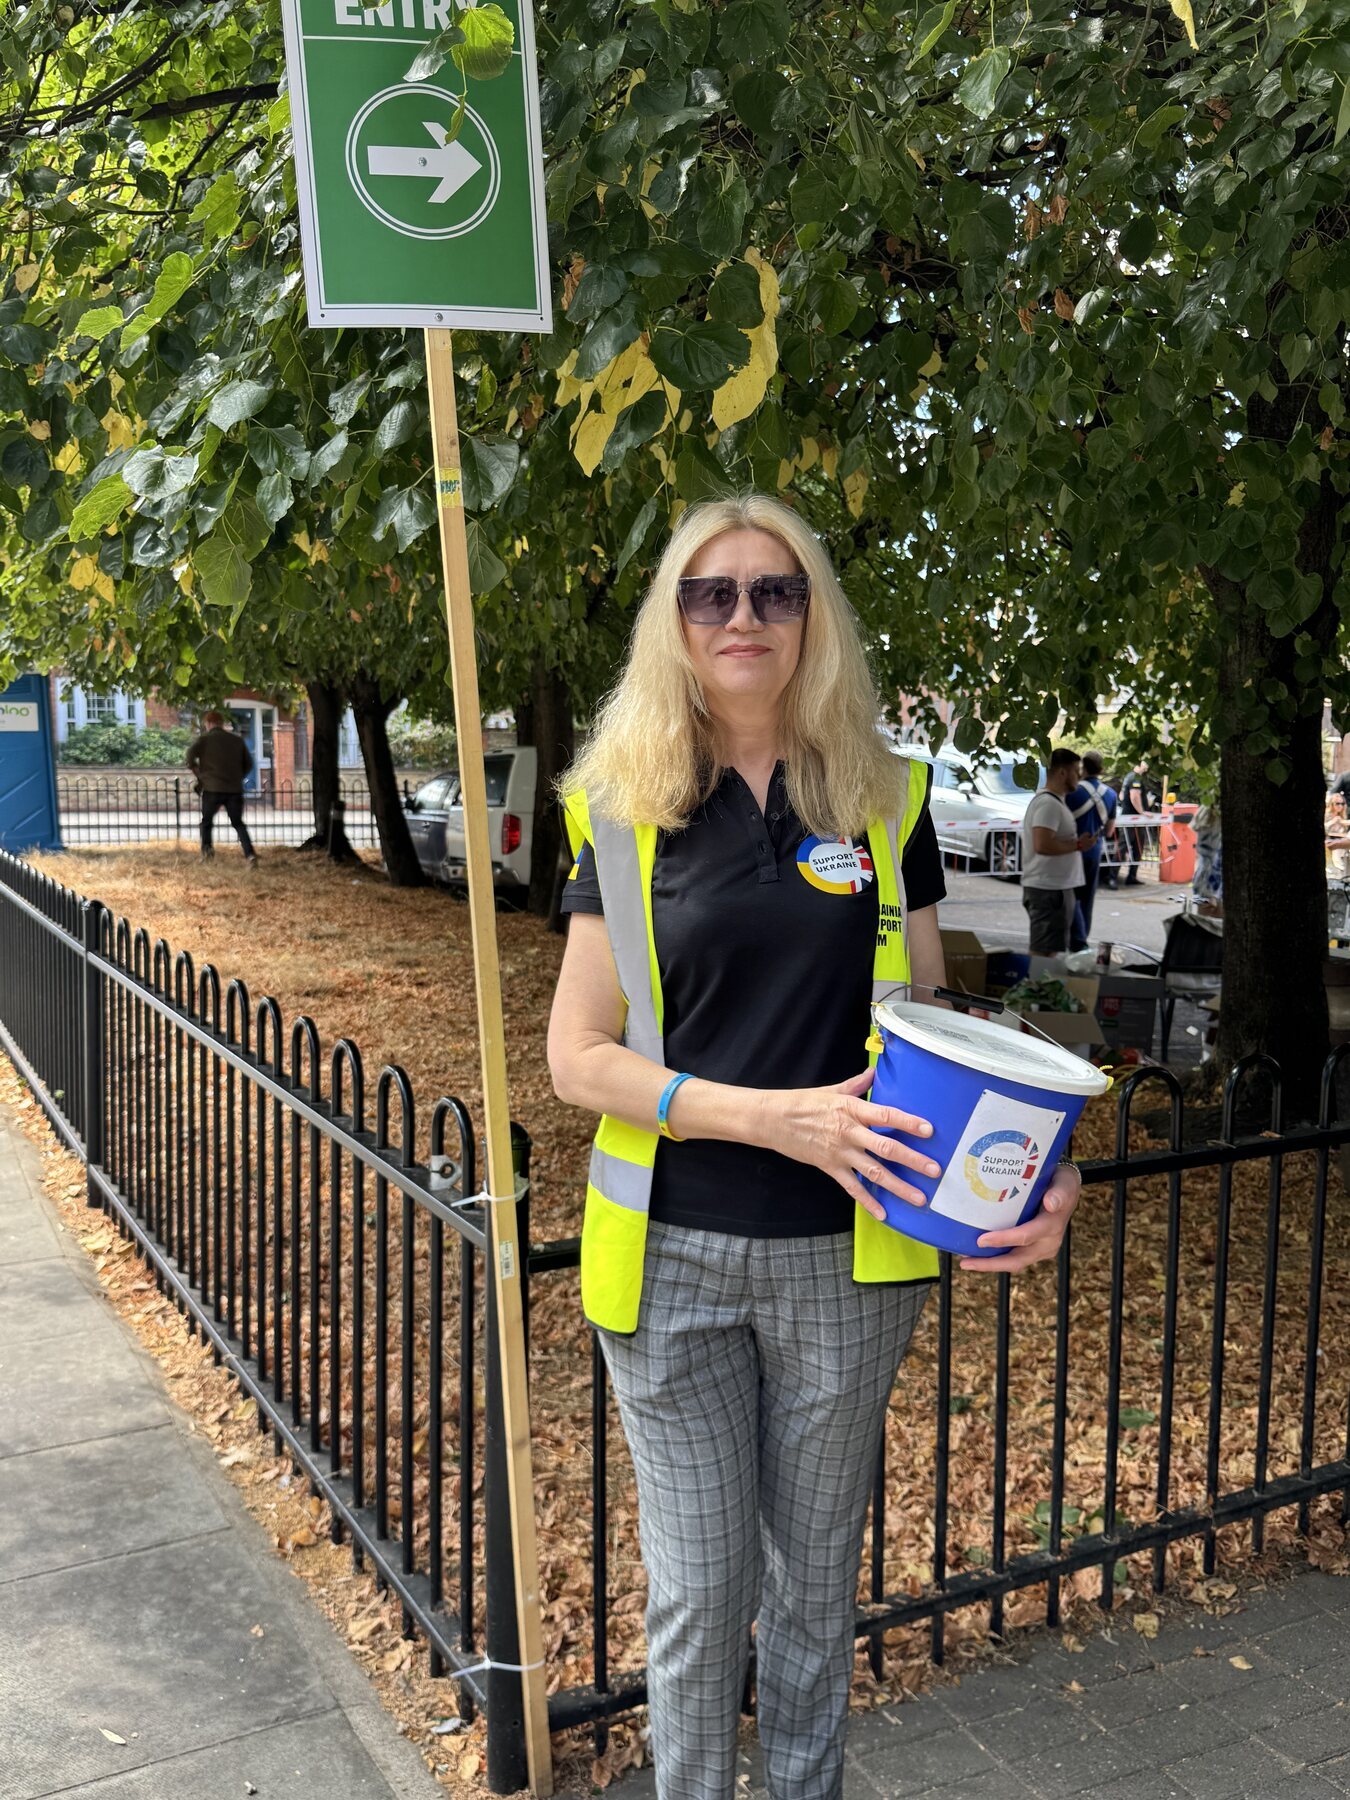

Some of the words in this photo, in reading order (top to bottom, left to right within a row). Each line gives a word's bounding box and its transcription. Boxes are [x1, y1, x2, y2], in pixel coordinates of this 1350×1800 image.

[334, 0, 478, 30] ENTR
[812, 853, 853, 865] SUPPORT
[816, 862, 858, 873] UKRAINE
[880, 919, 902, 932] PORT
[984, 1155, 1024, 1167] SUPPORT
[982, 1165, 1022, 1176] UKRAINE
